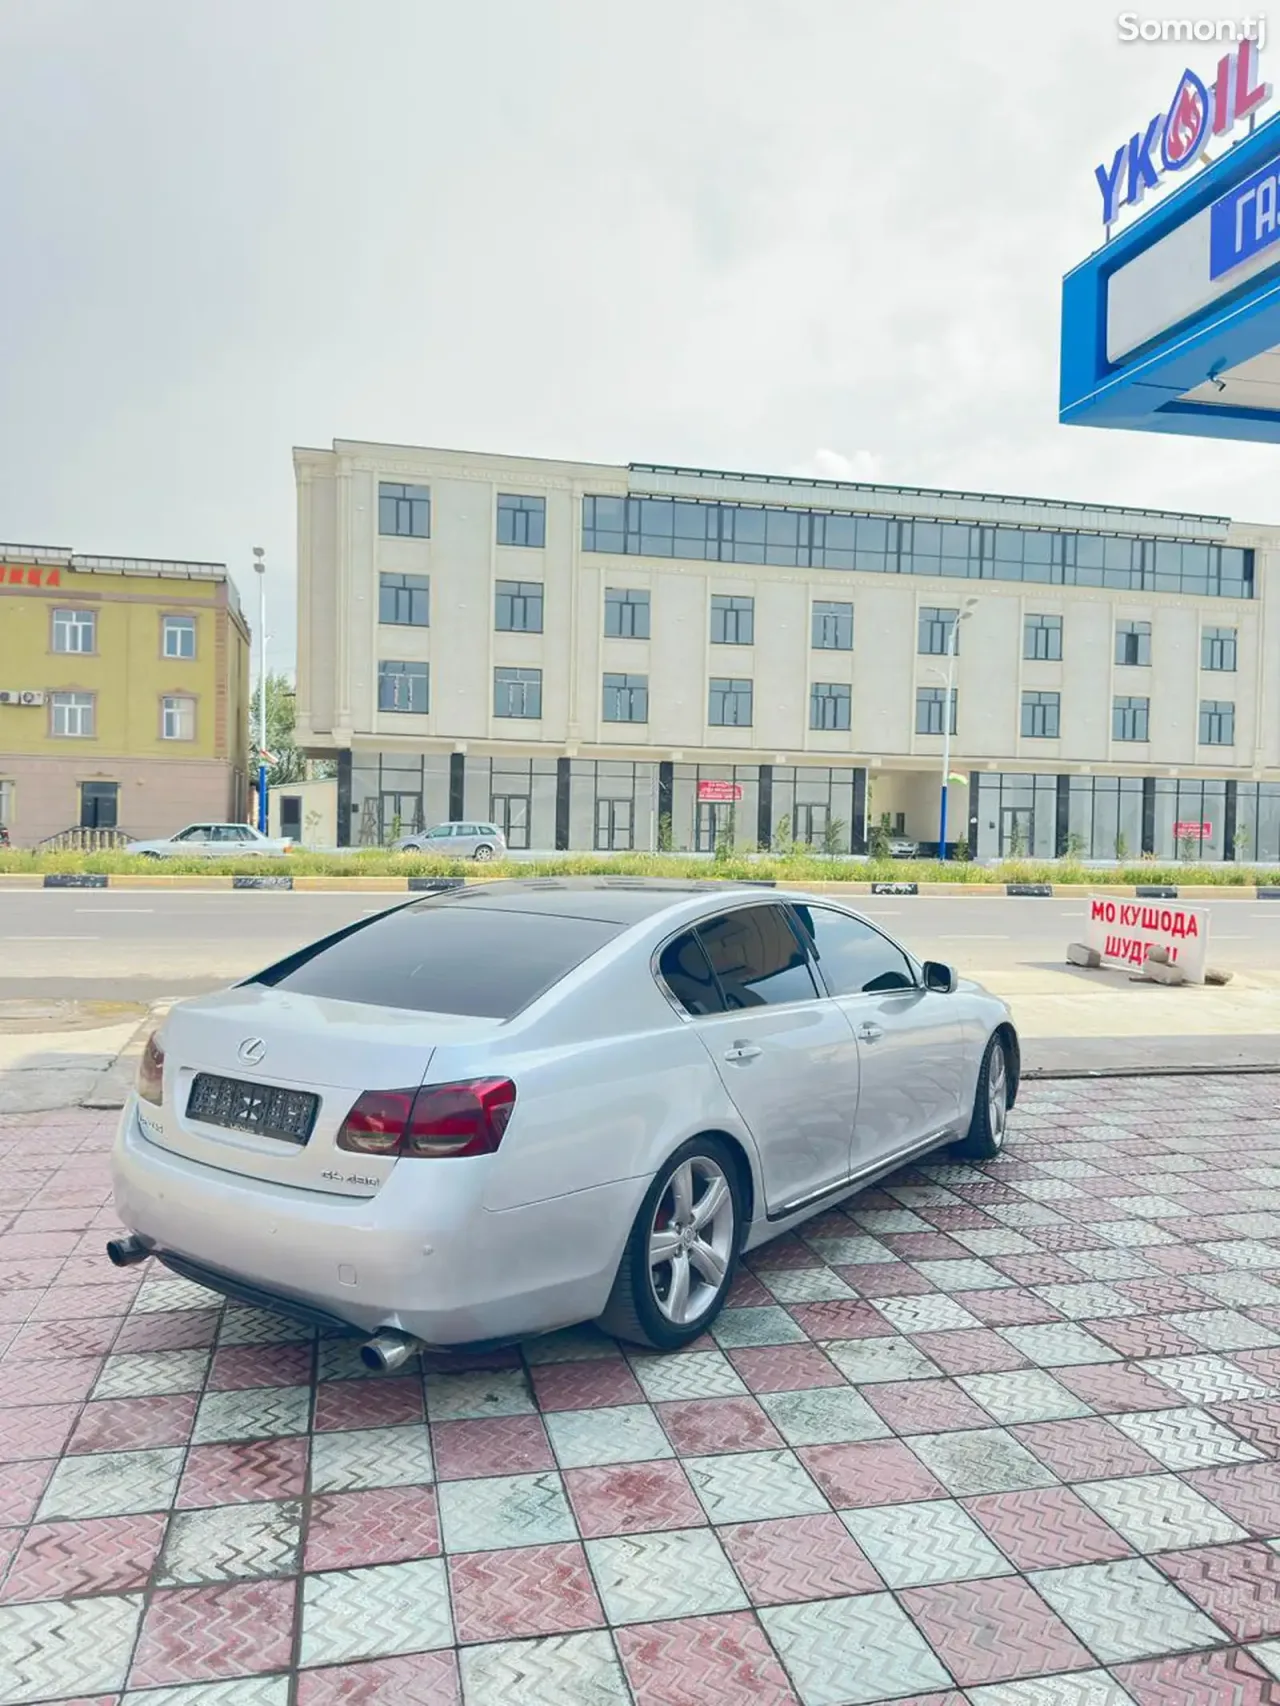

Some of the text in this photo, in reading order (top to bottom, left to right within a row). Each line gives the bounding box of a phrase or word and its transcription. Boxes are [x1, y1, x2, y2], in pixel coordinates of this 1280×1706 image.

[1235, 171, 1280, 254] ГА
[1091, 901, 1199, 938] МО КУШОДА
[1105, 936, 1179, 966] ШУД!
